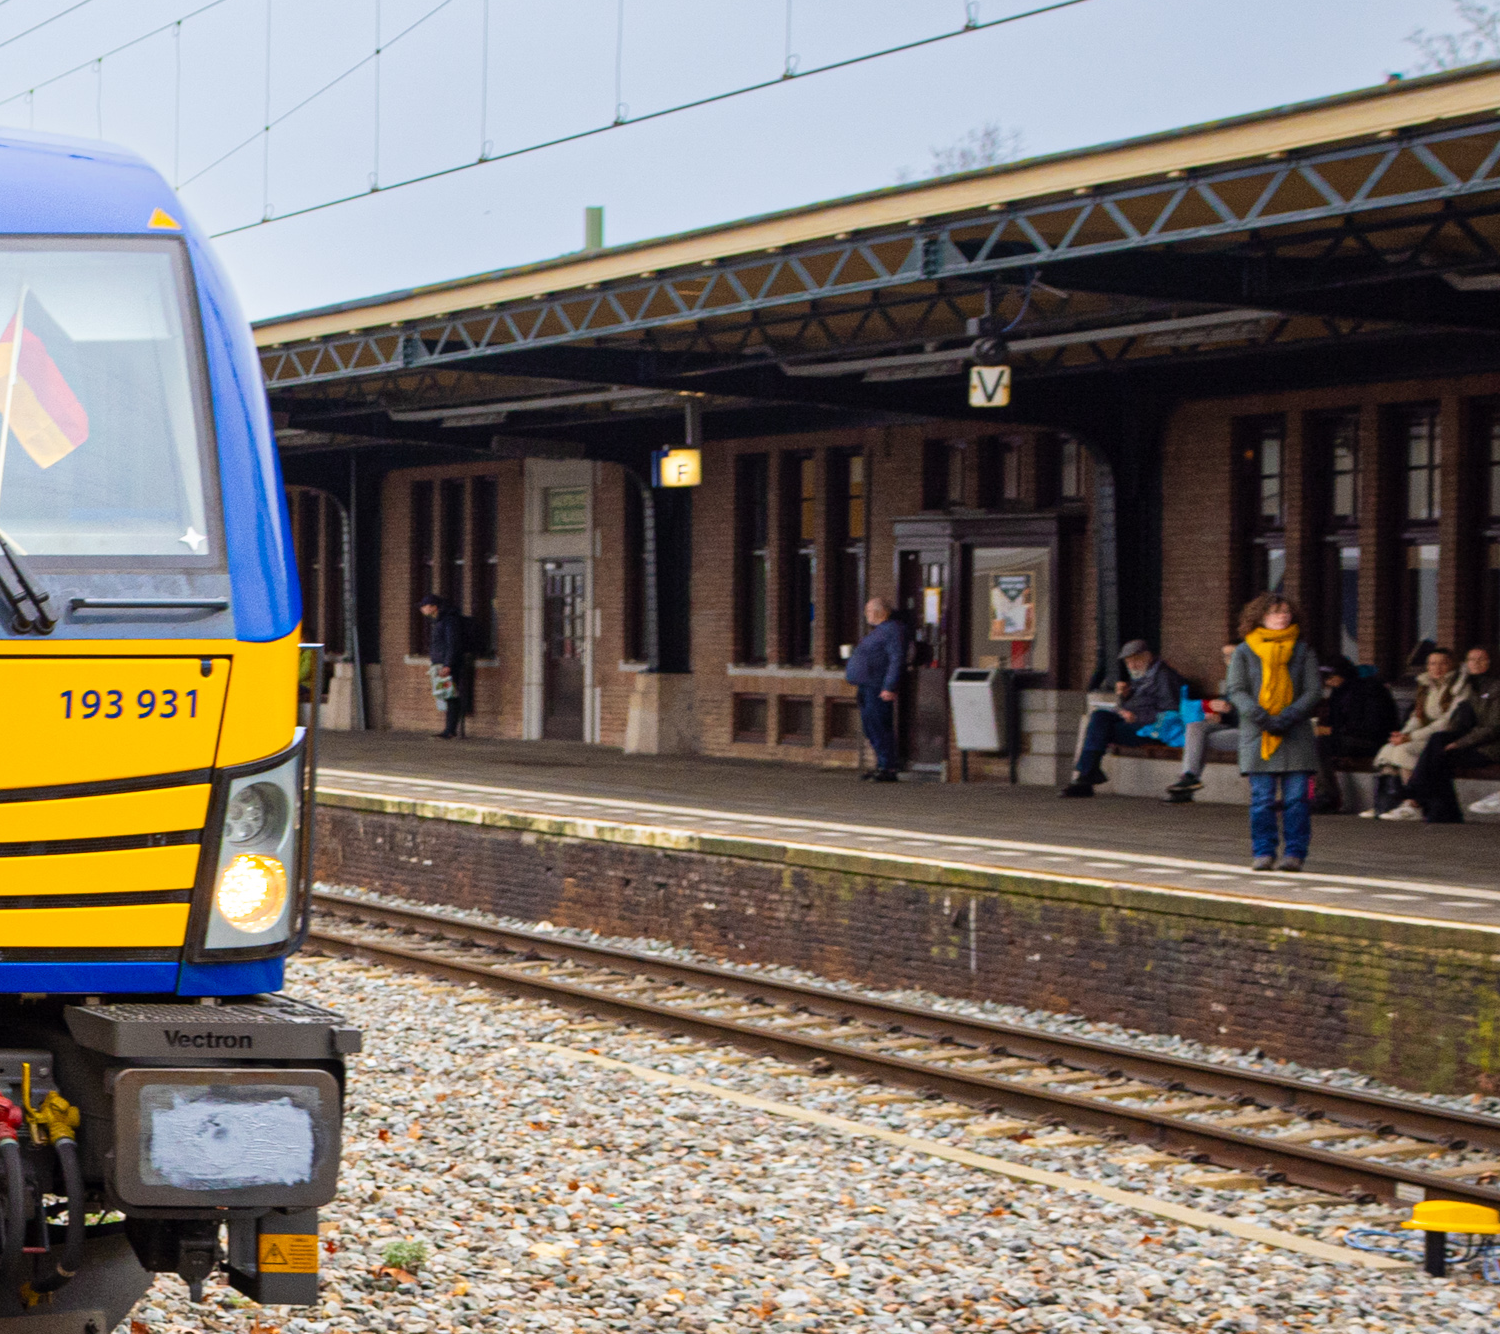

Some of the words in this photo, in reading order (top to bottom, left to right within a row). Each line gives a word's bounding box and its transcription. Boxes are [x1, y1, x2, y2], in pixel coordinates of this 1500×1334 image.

[977, 369, 1005, 403] V
[60, 689, 123, 719] 193
[137, 689, 197, 719] 931
[164, 1030, 253, 1049] Vectron
